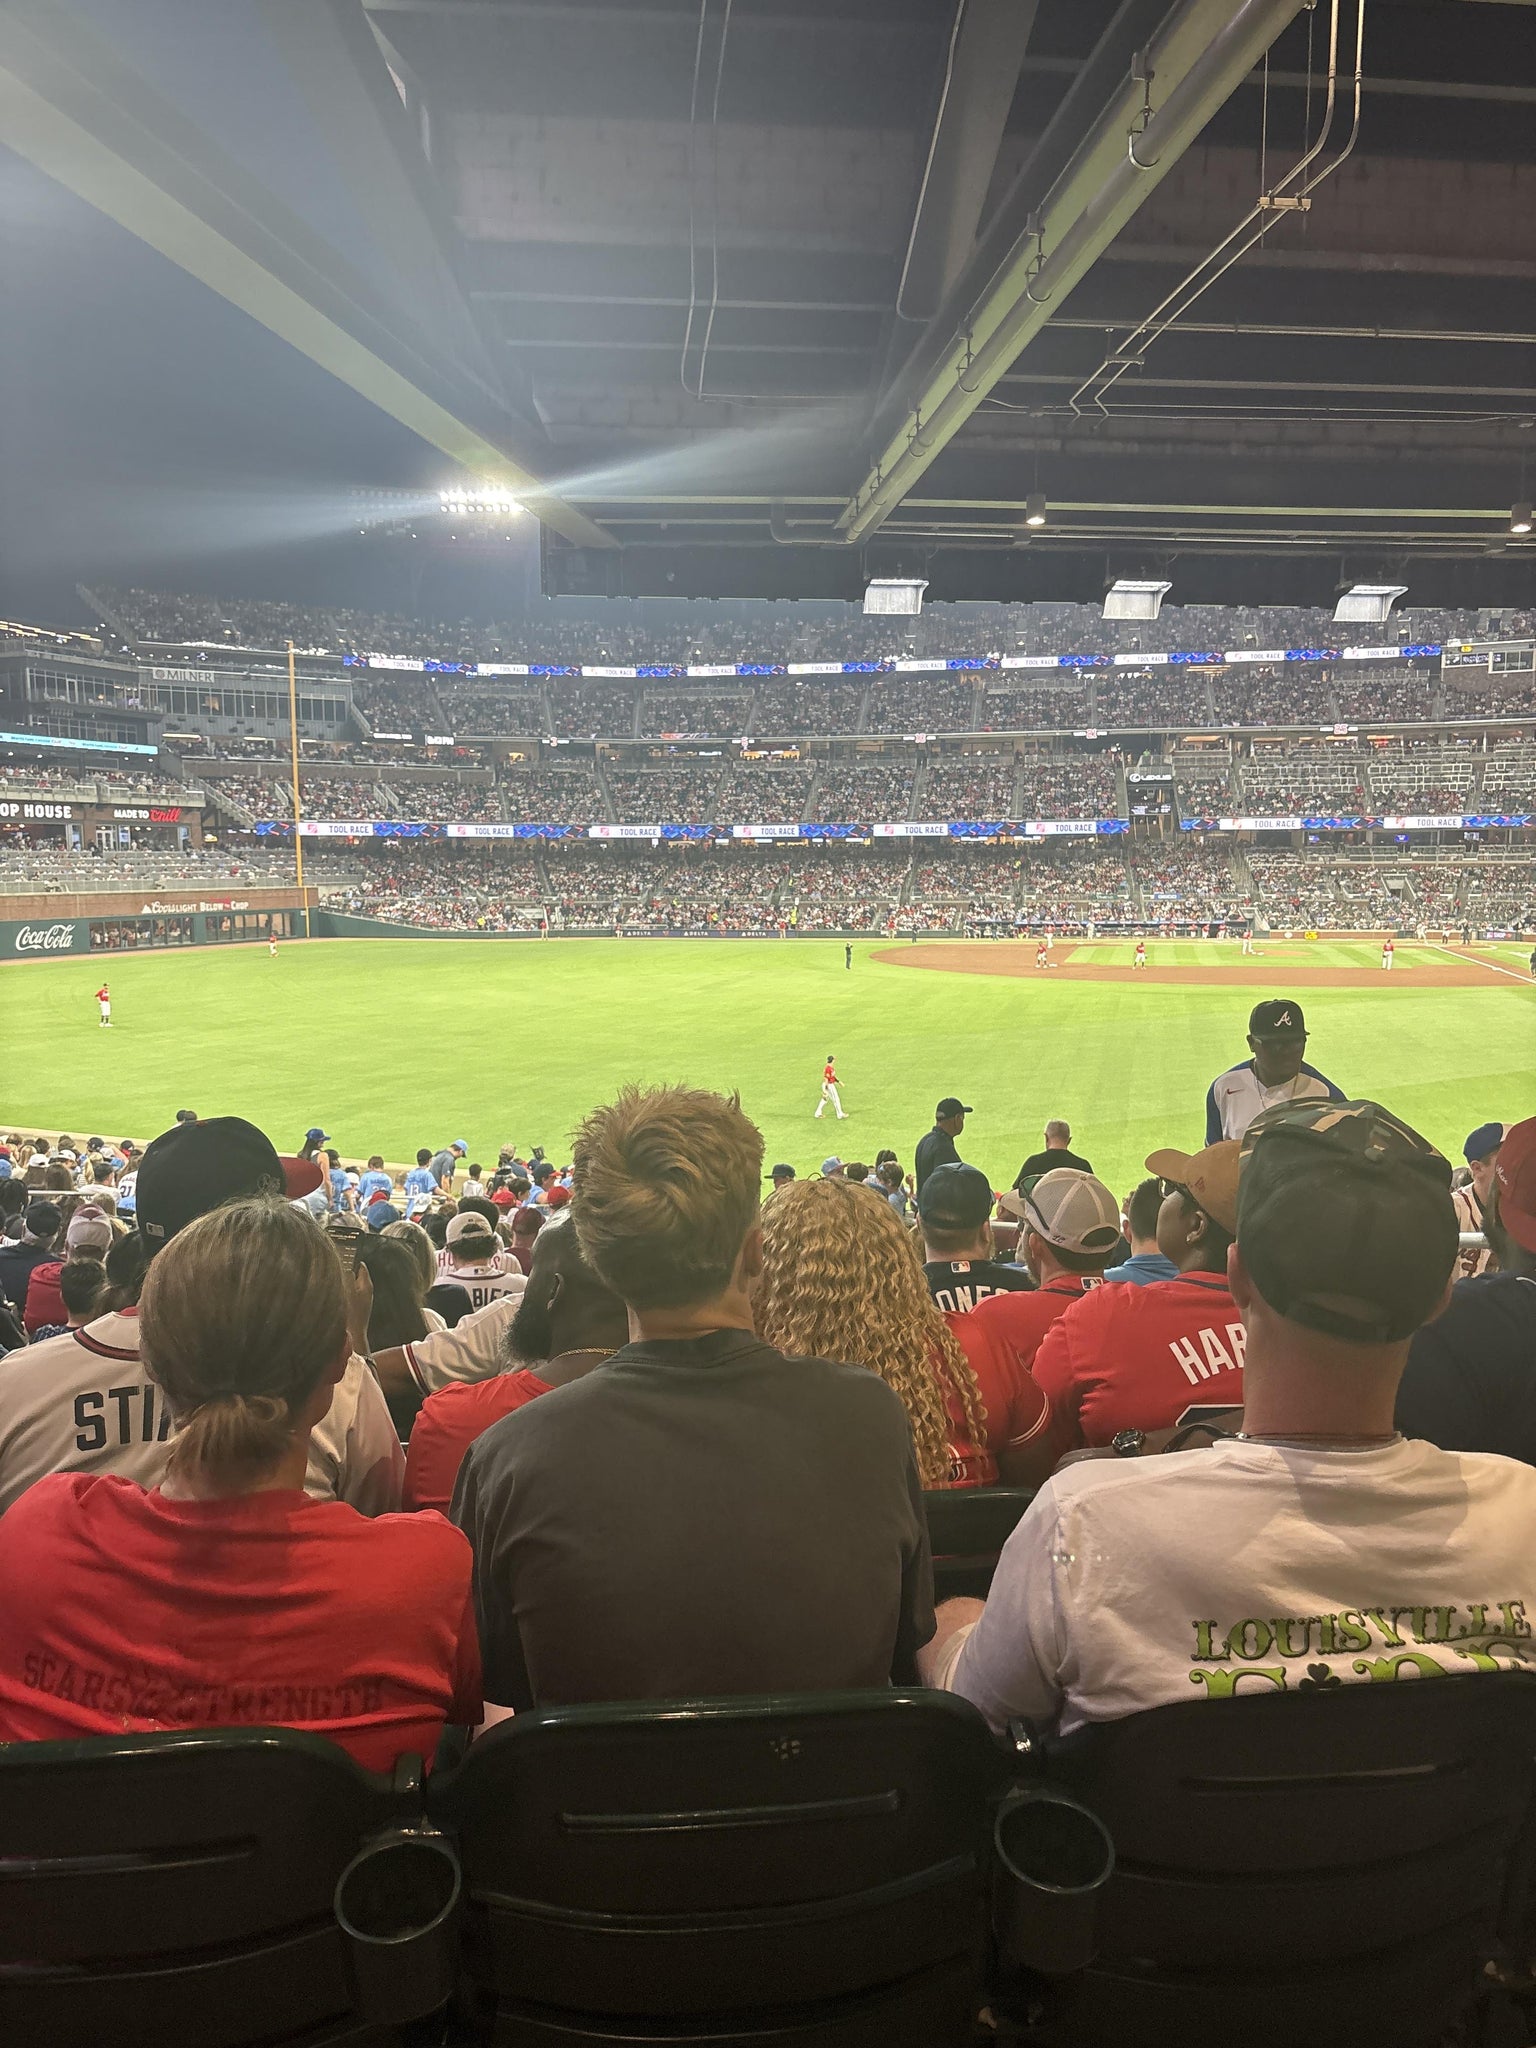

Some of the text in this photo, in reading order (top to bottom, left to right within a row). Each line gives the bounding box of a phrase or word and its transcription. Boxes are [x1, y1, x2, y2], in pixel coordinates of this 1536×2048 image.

[167, 670, 212, 682] MILNER
[24, 804, 73, 818] HOUSE
[114, 809, 137, 819] MADE
[138, 810, 149, 819] TO
[1254, 819, 1296, 828] TOOL RACE
[1417, 818, 1458, 827] TOOL RACE
[329, 825, 370, 834] TOOL RACE
[475, 827, 491, 835] TOOL
[620, 828, 638, 836] TOOL
[761, 827, 796, 835] TOOL RACE
[905, 826, 944, 834] TOOL RACE
[1055, 823, 1092, 832] TOOL RACE
[200, 902, 224, 912] BELOW
[16, 925, 75, 950] Coca-Cola
[1190, 1600, 1532, 1662] LOUISVILLE
